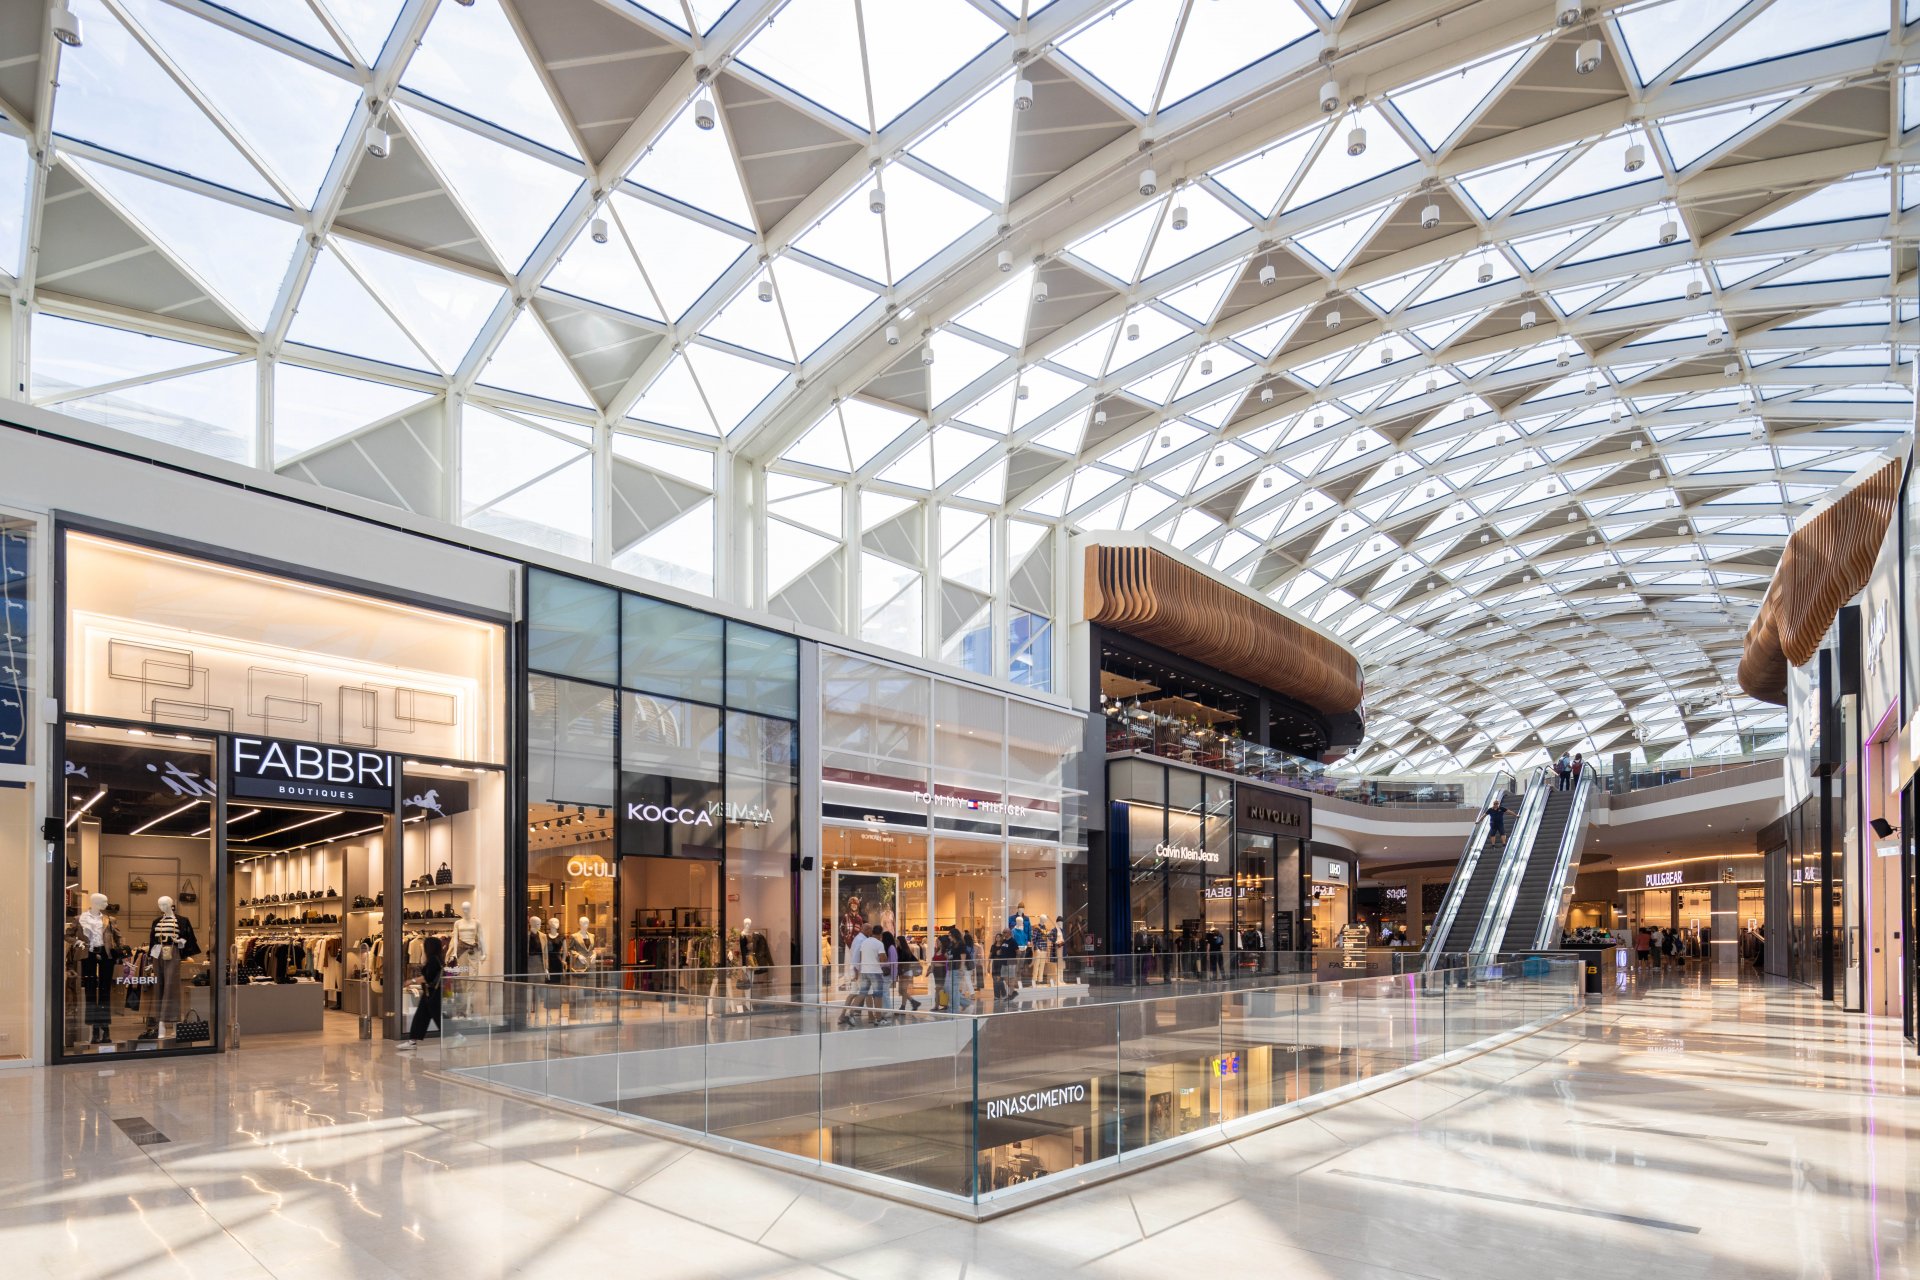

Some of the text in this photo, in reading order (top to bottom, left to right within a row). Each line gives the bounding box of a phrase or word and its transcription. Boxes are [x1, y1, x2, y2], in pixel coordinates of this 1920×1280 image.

[234, 738, 392, 787] FABBRI
[279, 786, 354, 799] BOUTIQUES
[913, 791, 1026, 817] TOMMY HILFIGER
[628, 803, 712, 827] KOCCA
[1155, 844, 1219, 863] Calvin Klein Jeans
[1645, 871, 1683, 886] PULL&BEAR
[116, 976, 158, 985] FABBRI
[986, 1085, 1084, 1120] RINASCIMENTO
